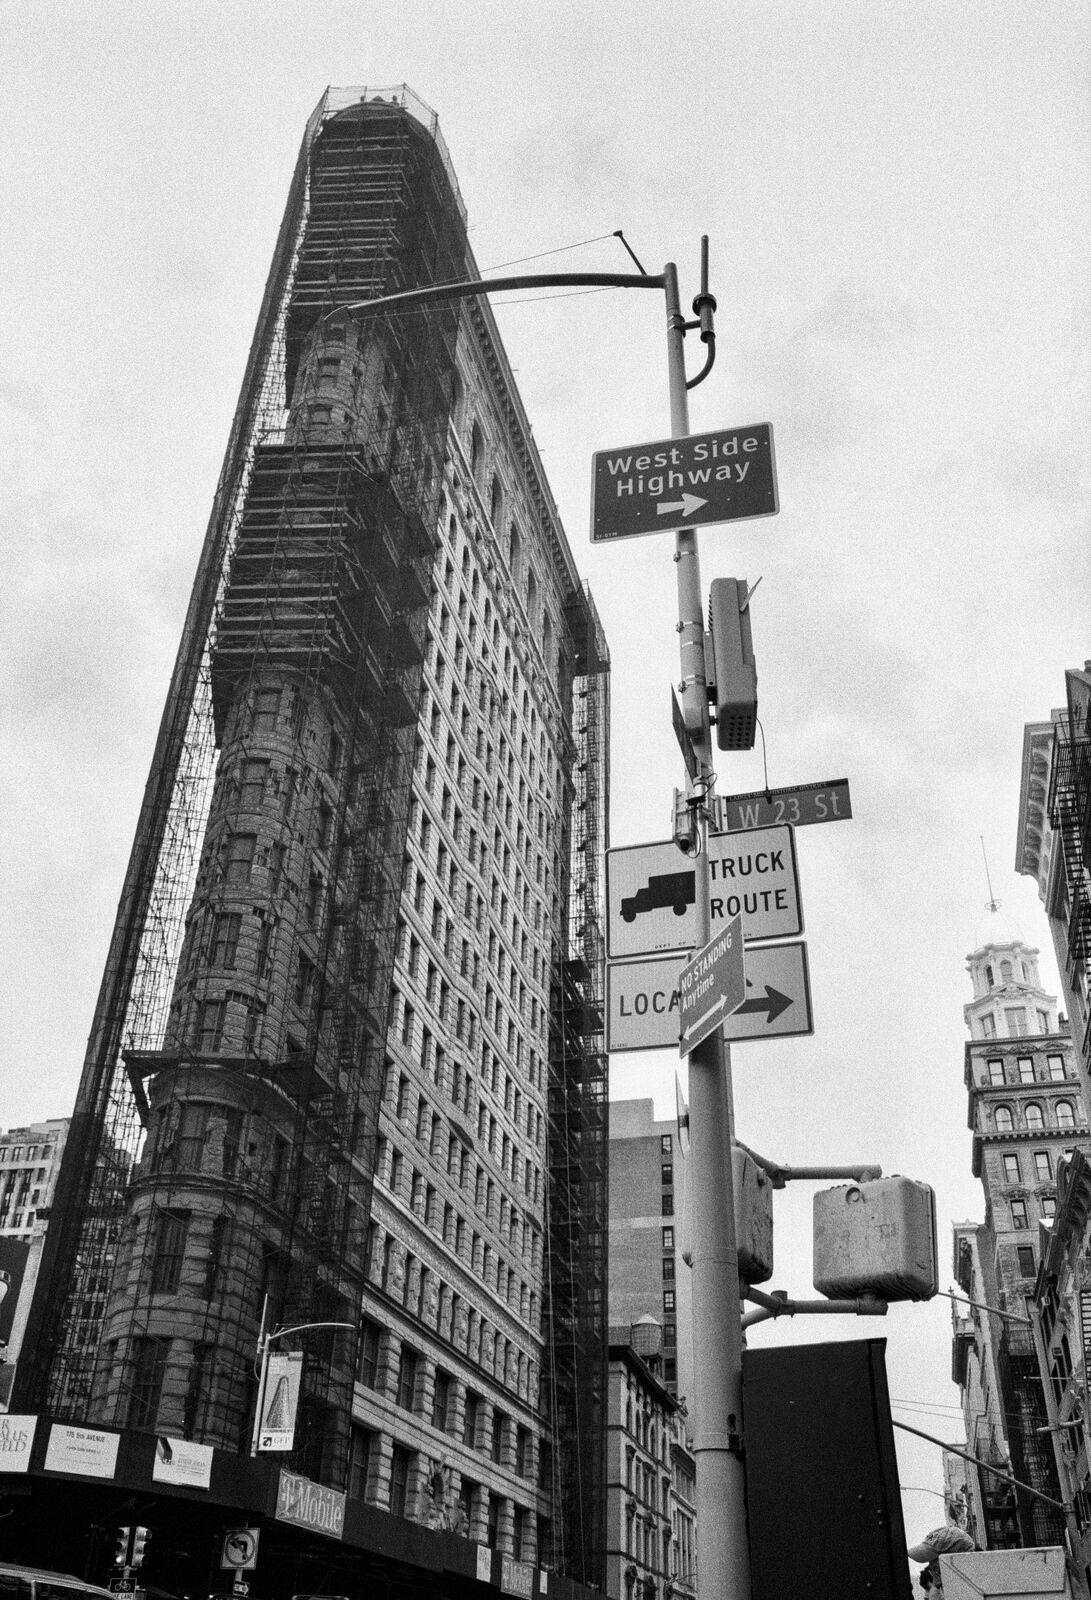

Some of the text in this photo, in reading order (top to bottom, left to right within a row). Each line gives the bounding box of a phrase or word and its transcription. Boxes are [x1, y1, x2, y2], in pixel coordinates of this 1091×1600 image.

[607, 436, 759, 475] West Side
[616, 461, 750, 497] Highway
[738, 791, 841, 828] W 23 St
[708, 850, 785, 881] TRUCK
[710, 888, 788, 919] ROUTE
[681, 932, 732, 994] NO STANDING
[619, 989, 681, 1017] LOCA
[682, 973, 715, 1013] Anytime
[85, 1433, 106, 1443] AVENUE
